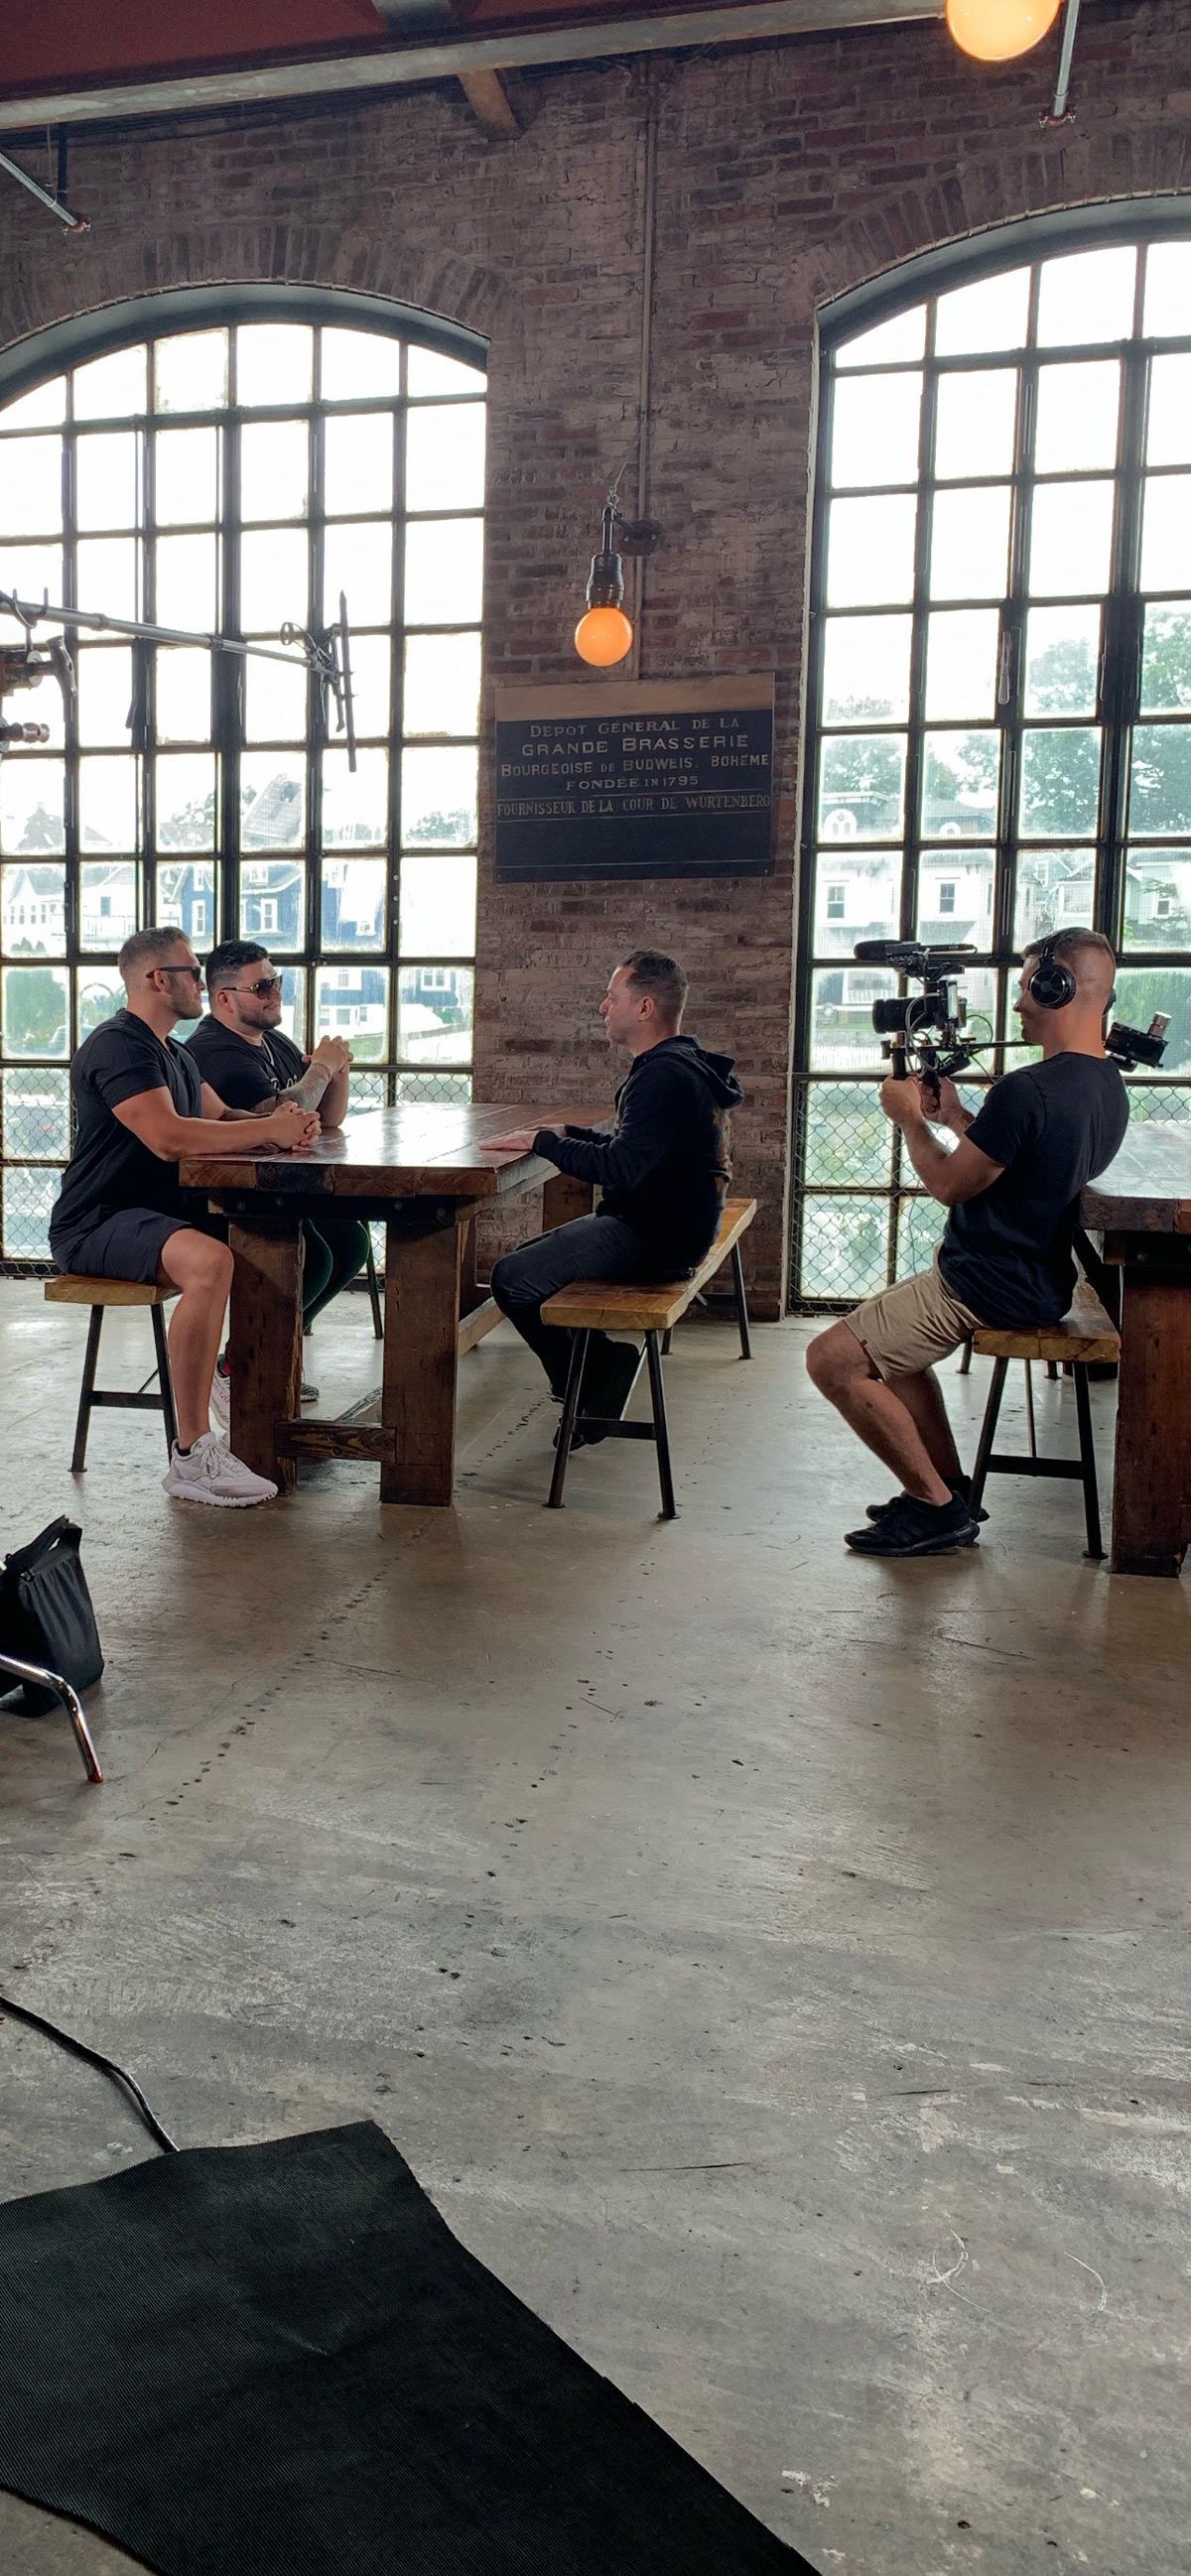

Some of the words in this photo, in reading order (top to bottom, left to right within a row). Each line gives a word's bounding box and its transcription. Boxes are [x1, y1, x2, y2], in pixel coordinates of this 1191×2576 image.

[692, 718, 710, 730] DE
[720, 716, 739, 729] LA
[522, 740, 608, 757] GRANDE
[622, 734, 748, 752] BRASSERIE
[501, 761, 594, 777] BOURGEOISE
[600, 763, 614, 773] DE
[644, 778, 659, 787] IN
[663, 775, 699, 787] 1795
[497, 800, 577, 817] FOURNISSEUR
[581, 800, 596, 814] DE
[598, 799, 613, 813] LA
[622, 798, 654, 811] COUR
[661, 797, 677, 810] DE
